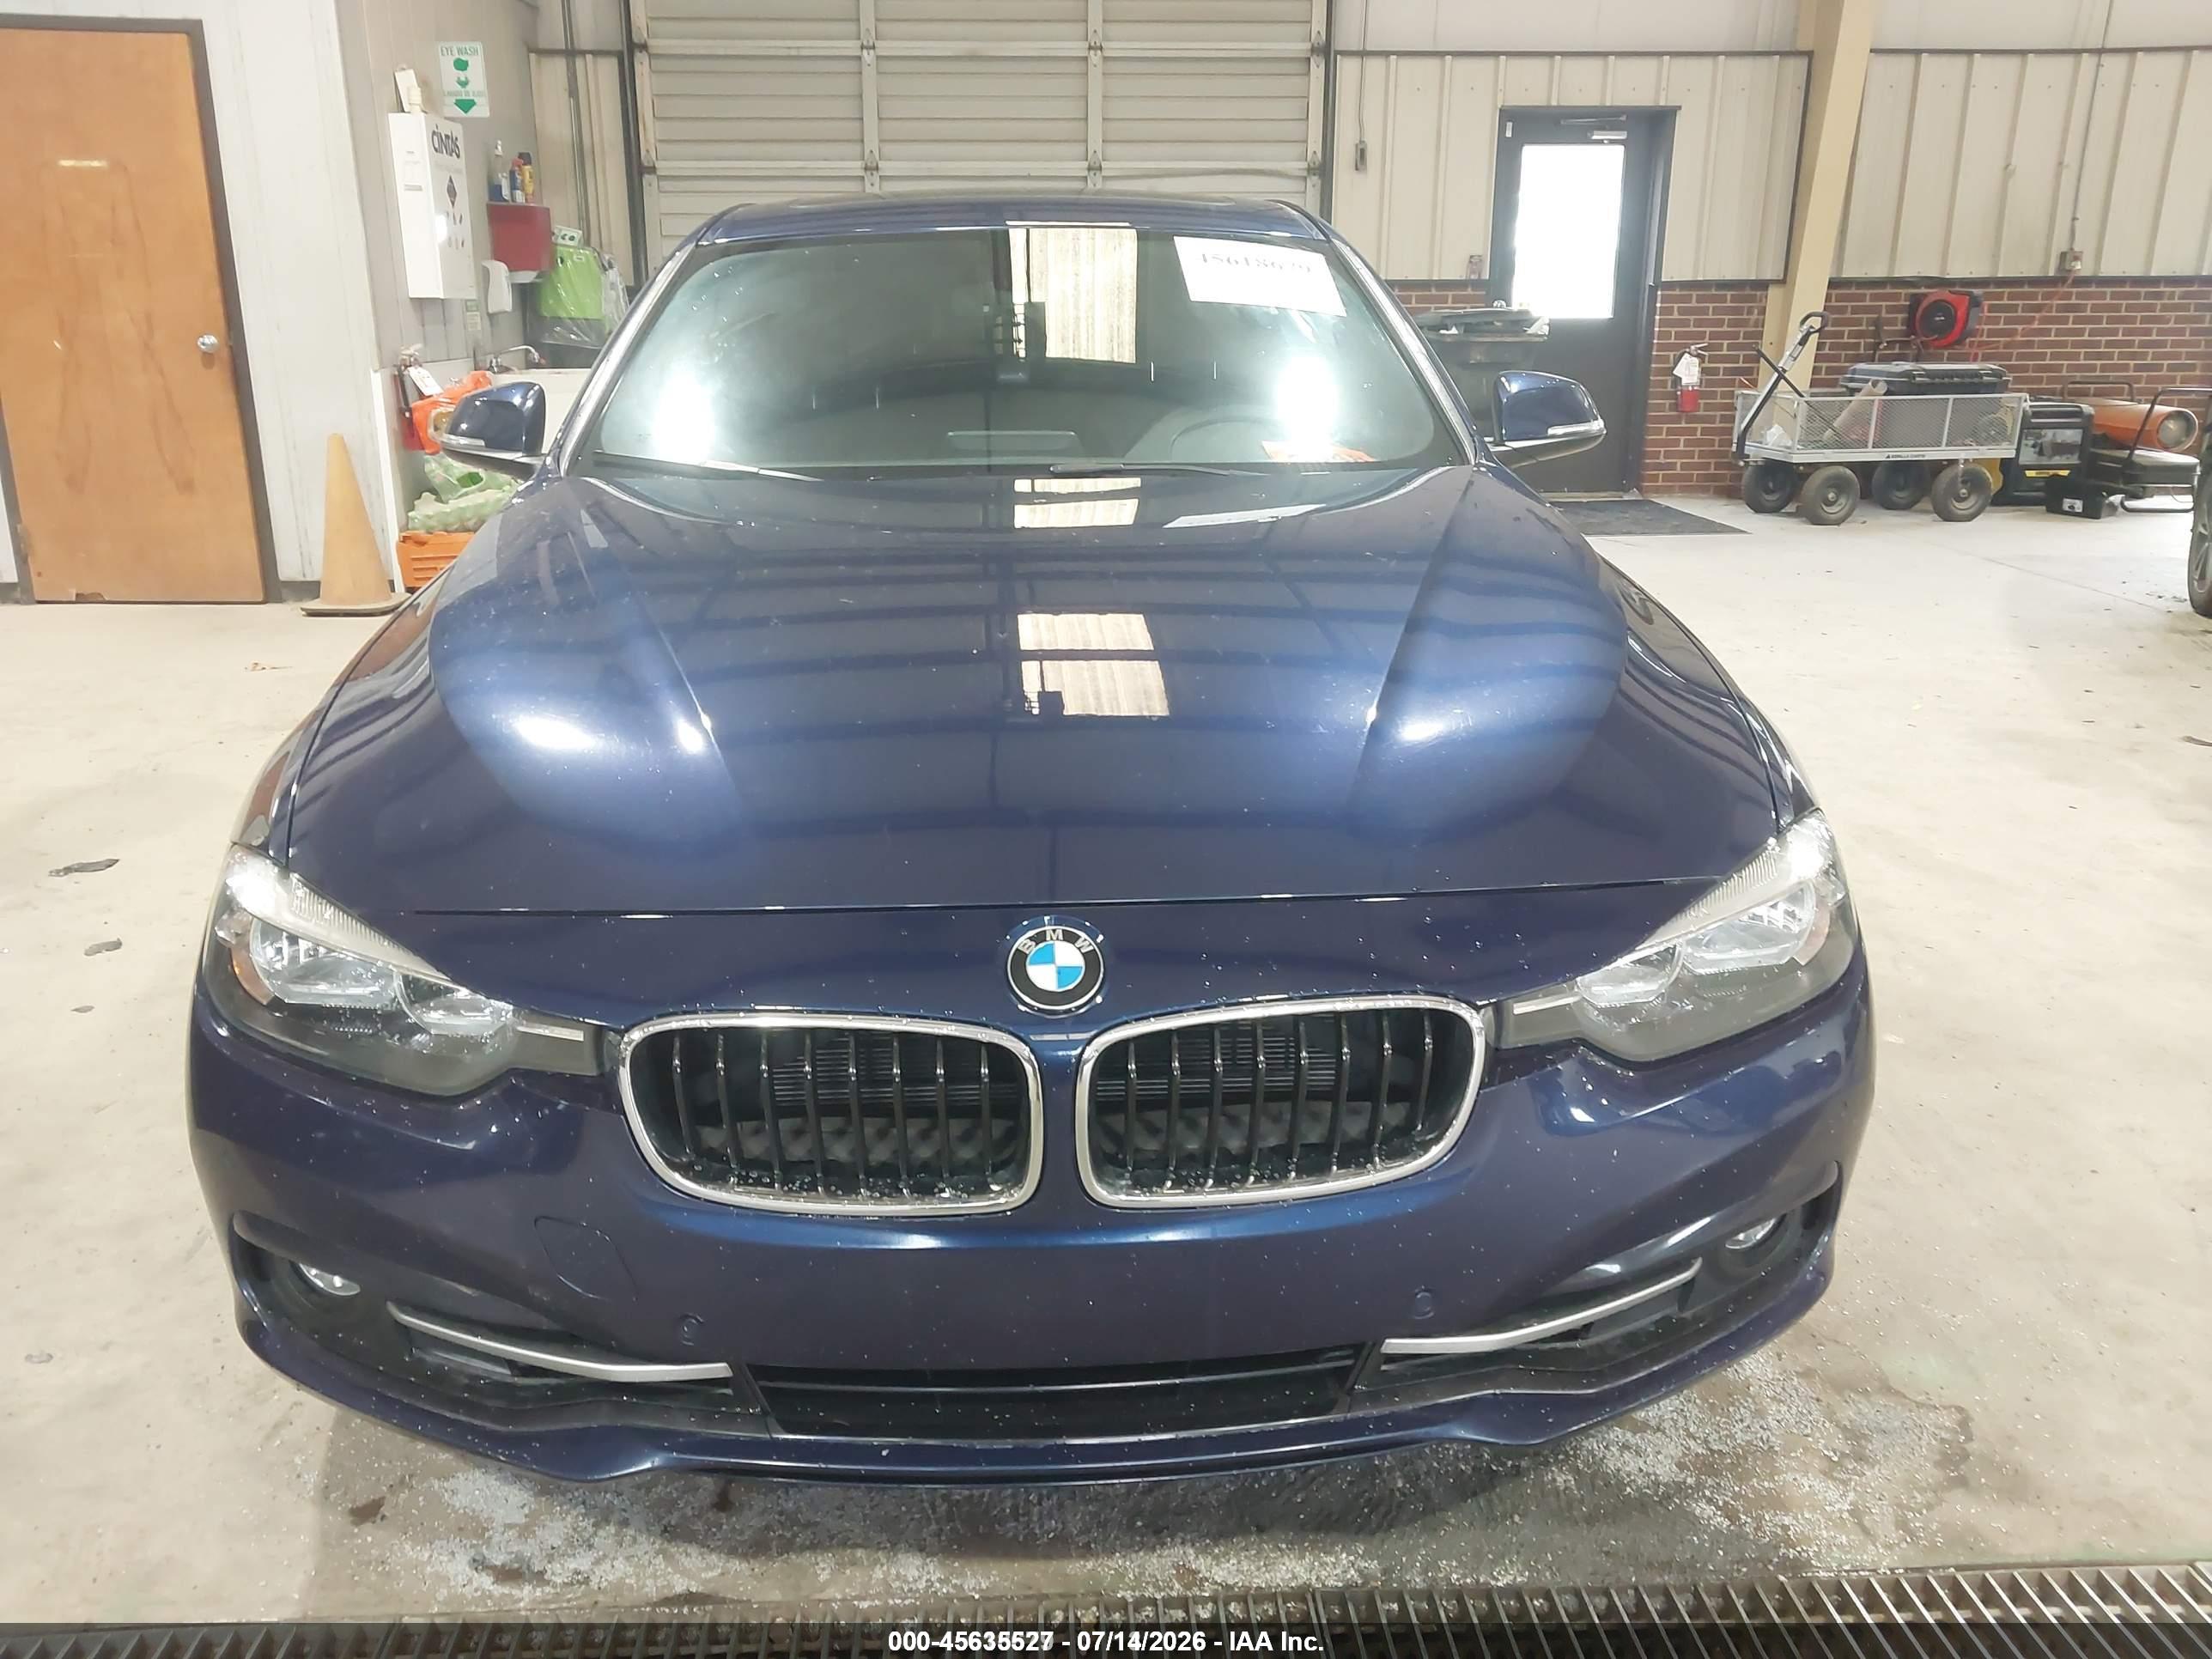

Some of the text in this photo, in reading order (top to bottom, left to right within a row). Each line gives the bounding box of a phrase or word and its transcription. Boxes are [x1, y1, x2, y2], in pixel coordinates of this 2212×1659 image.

[440, 45, 479, 57] EYE WASH
[1017, 928, 1095, 955] BMW
